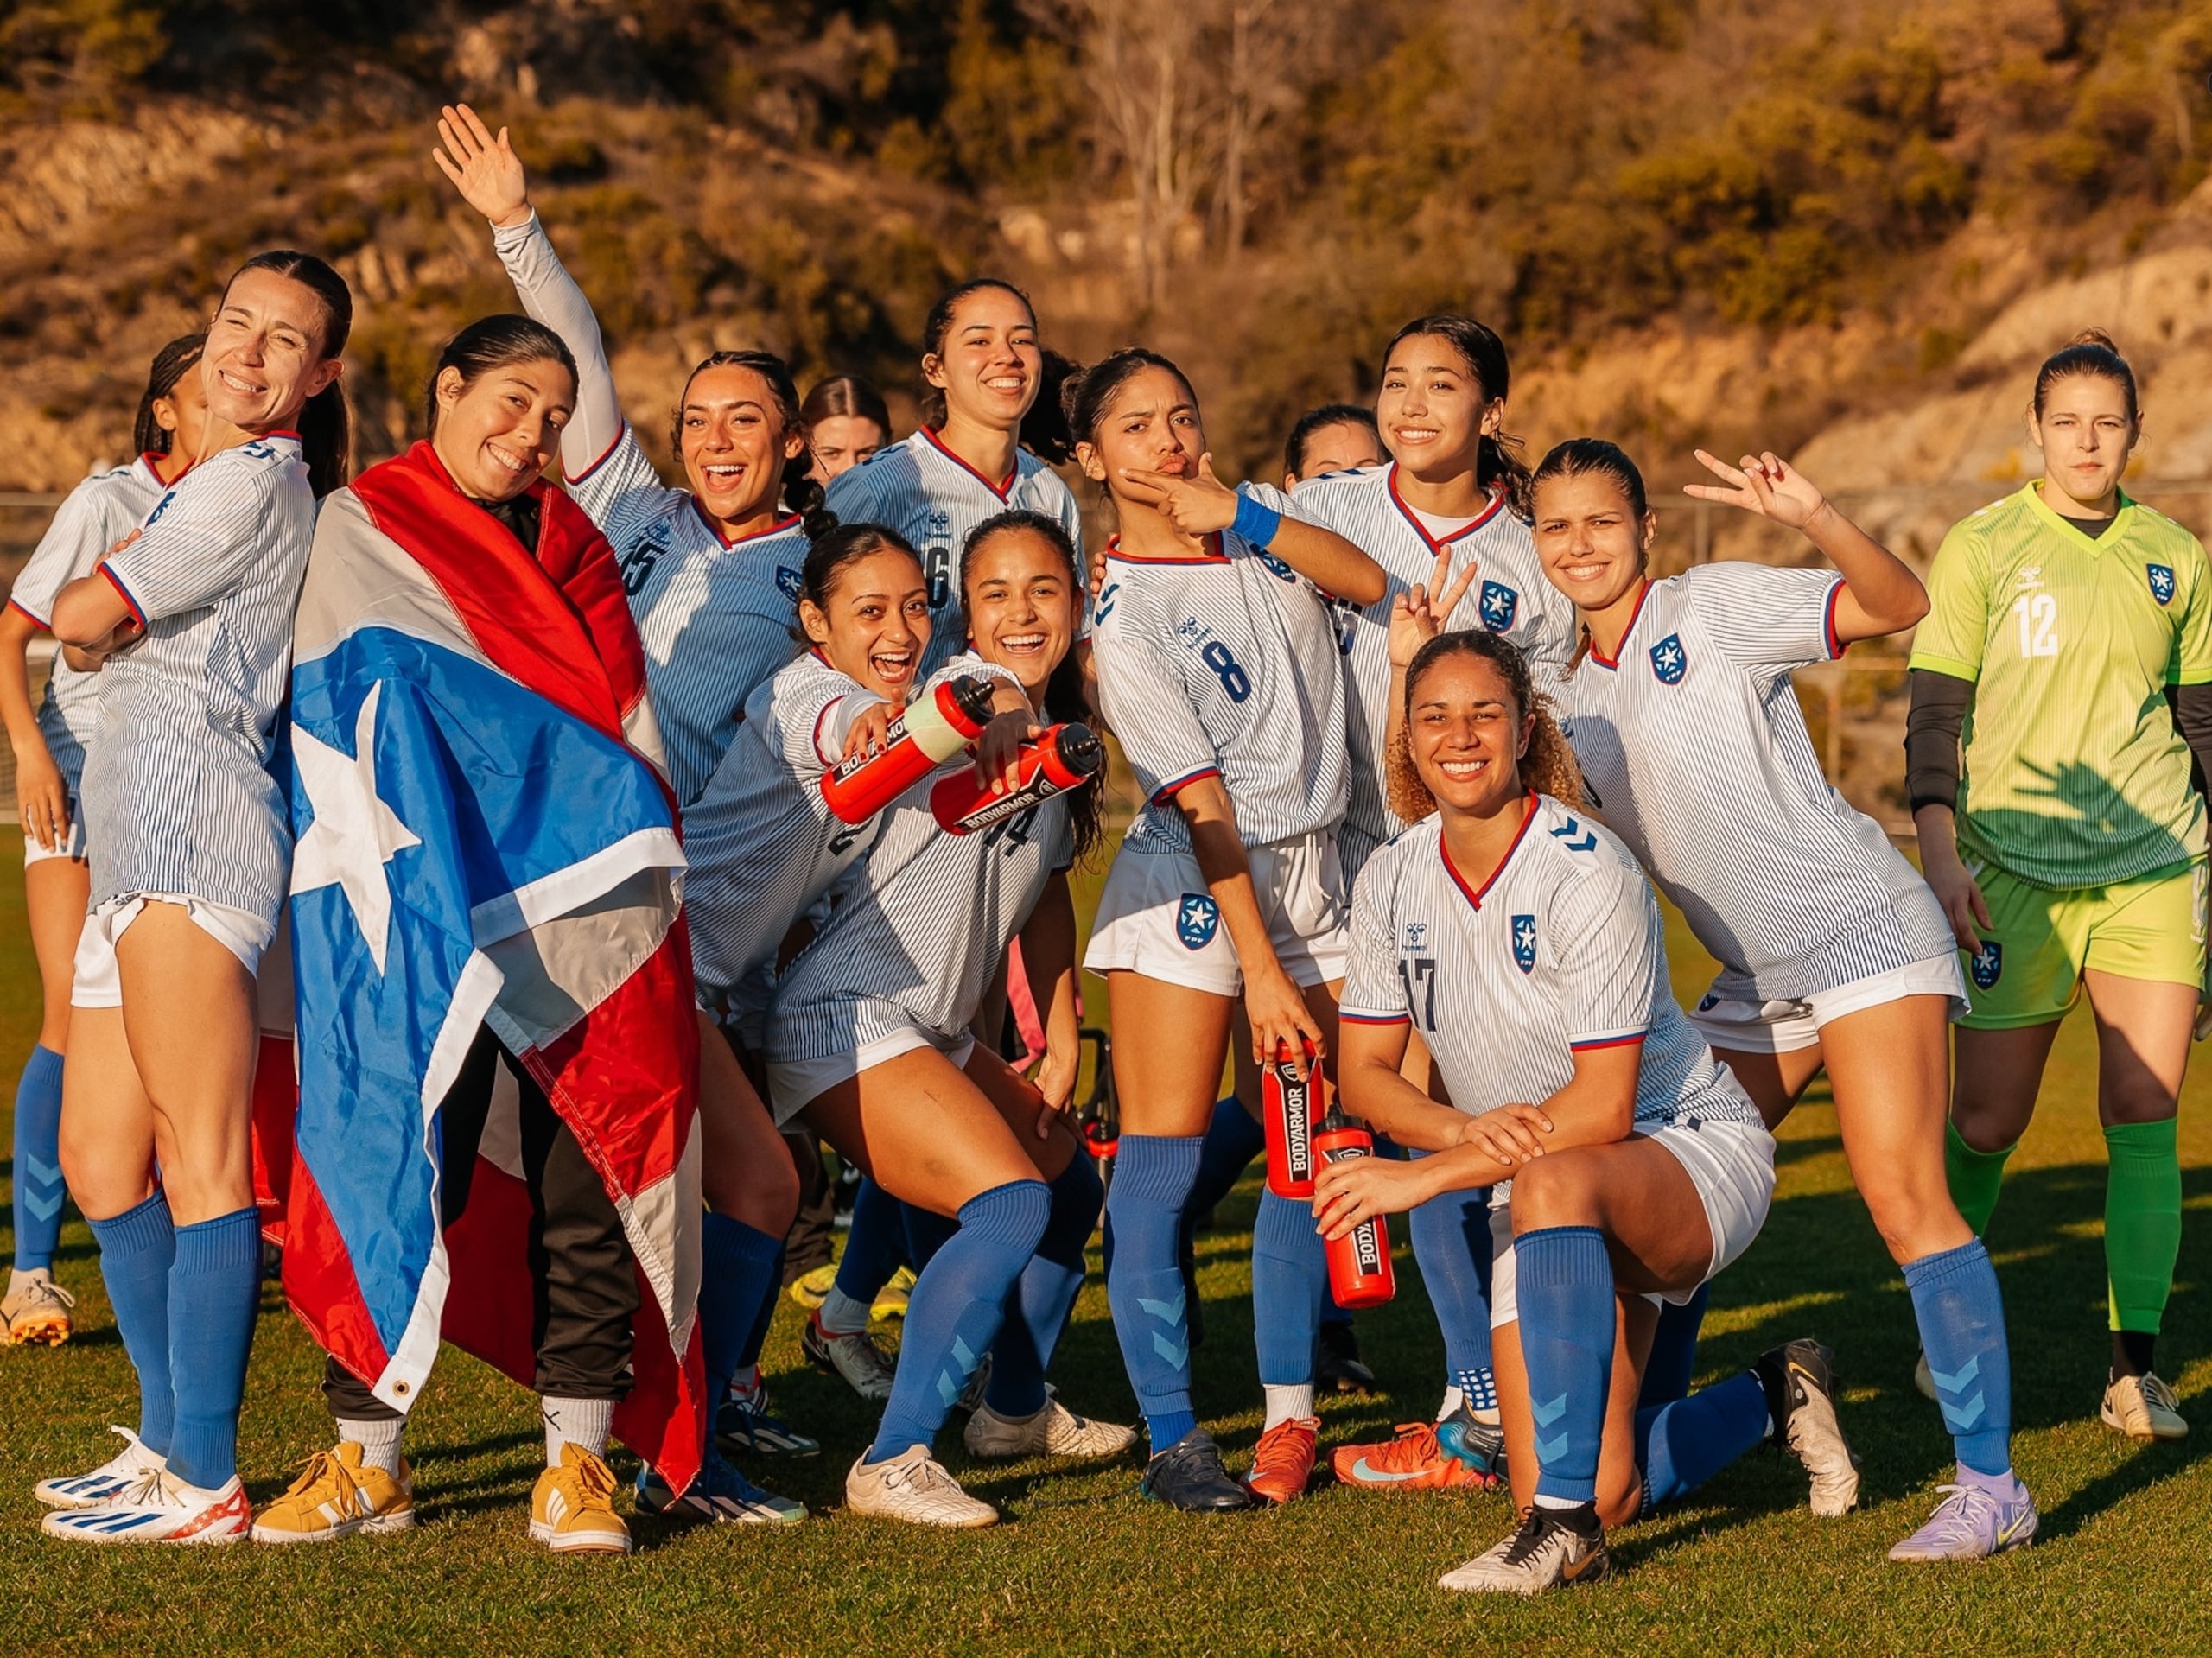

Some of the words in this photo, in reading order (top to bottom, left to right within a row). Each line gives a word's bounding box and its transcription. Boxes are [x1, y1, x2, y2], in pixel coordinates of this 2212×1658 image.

[926, 547, 949, 608] 6
[2013, 594, 2058, 658] 12
[1202, 640, 1252, 703] 8
[964, 792, 1039, 829] BODYARMOR
[1398, 959, 1436, 1032] 17
[1287, 1087, 1307, 1172] BODYARMOR
